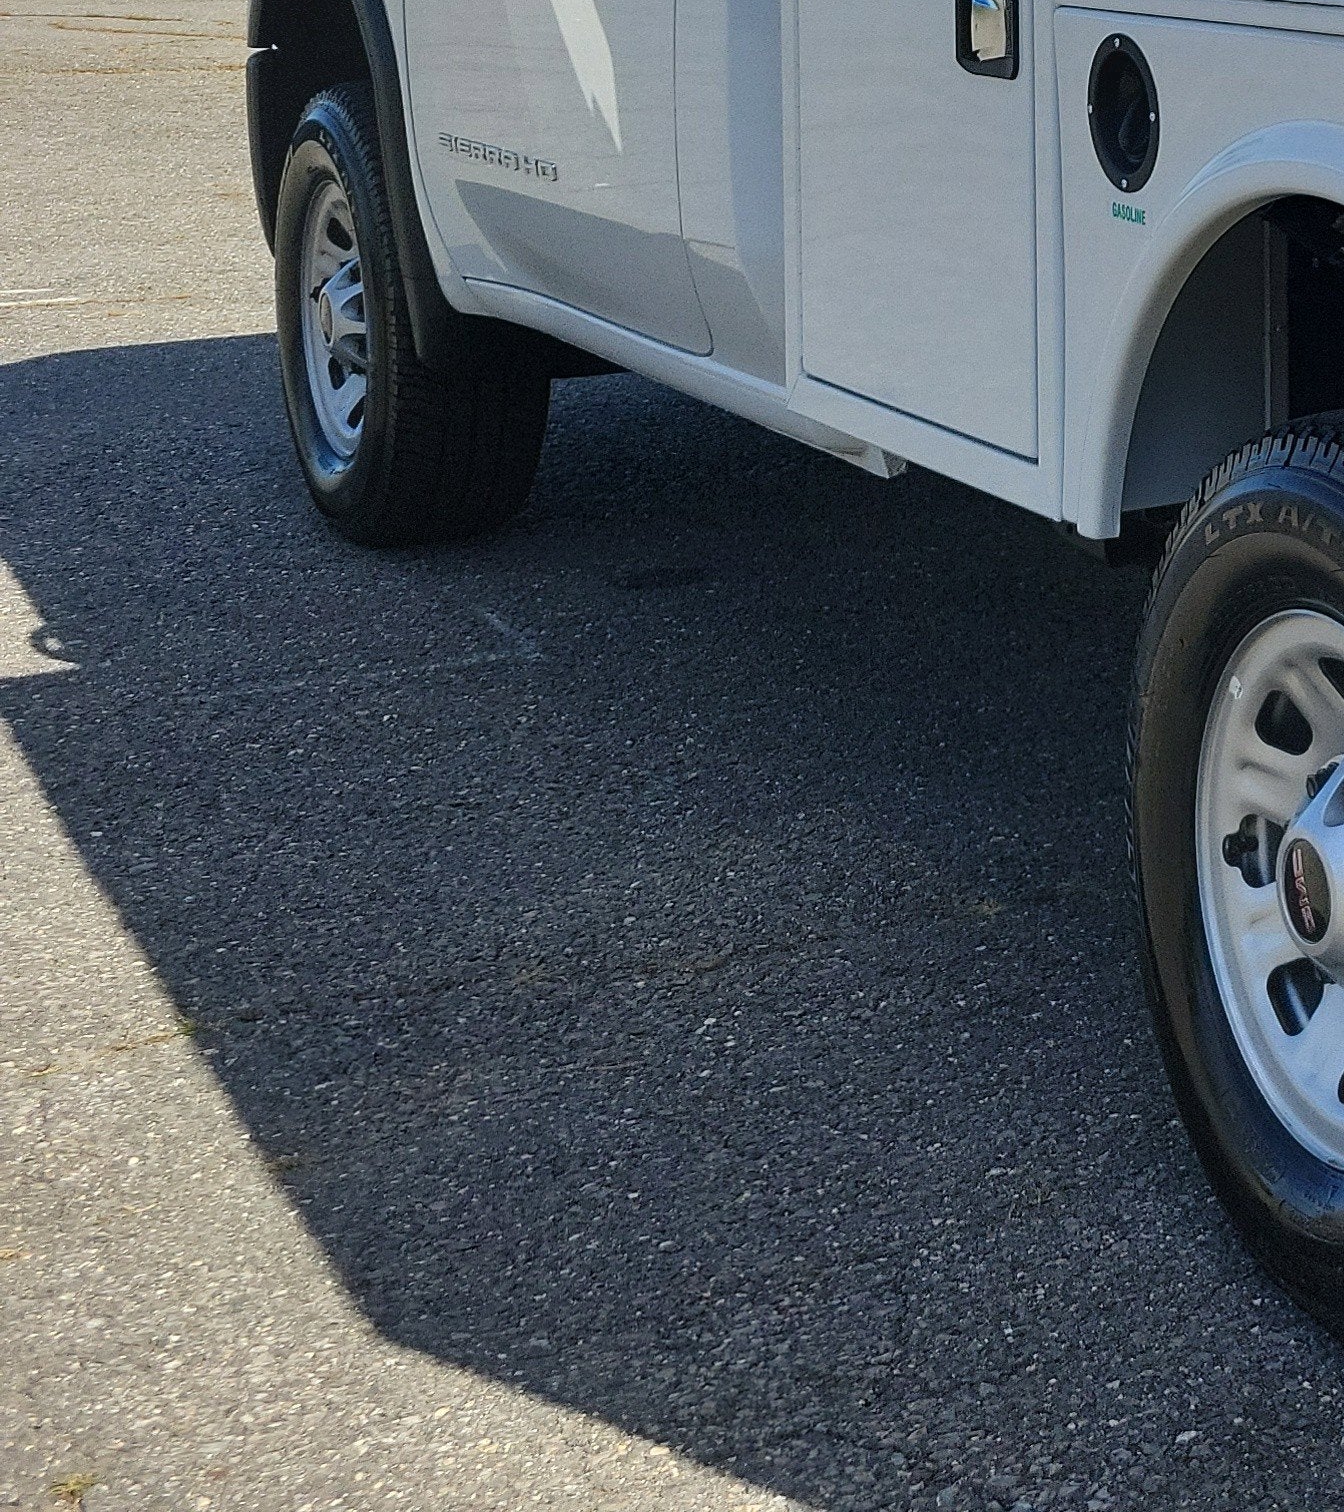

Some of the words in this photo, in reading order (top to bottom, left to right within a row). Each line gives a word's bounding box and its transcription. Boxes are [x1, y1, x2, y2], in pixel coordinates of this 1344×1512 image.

[438, 131, 520, 171] SIERRA
[1111, 201, 1147, 226] GASOLINE
[1205, 502, 1264, 546] LTX
[1292, 848, 1316, 934] GMC
